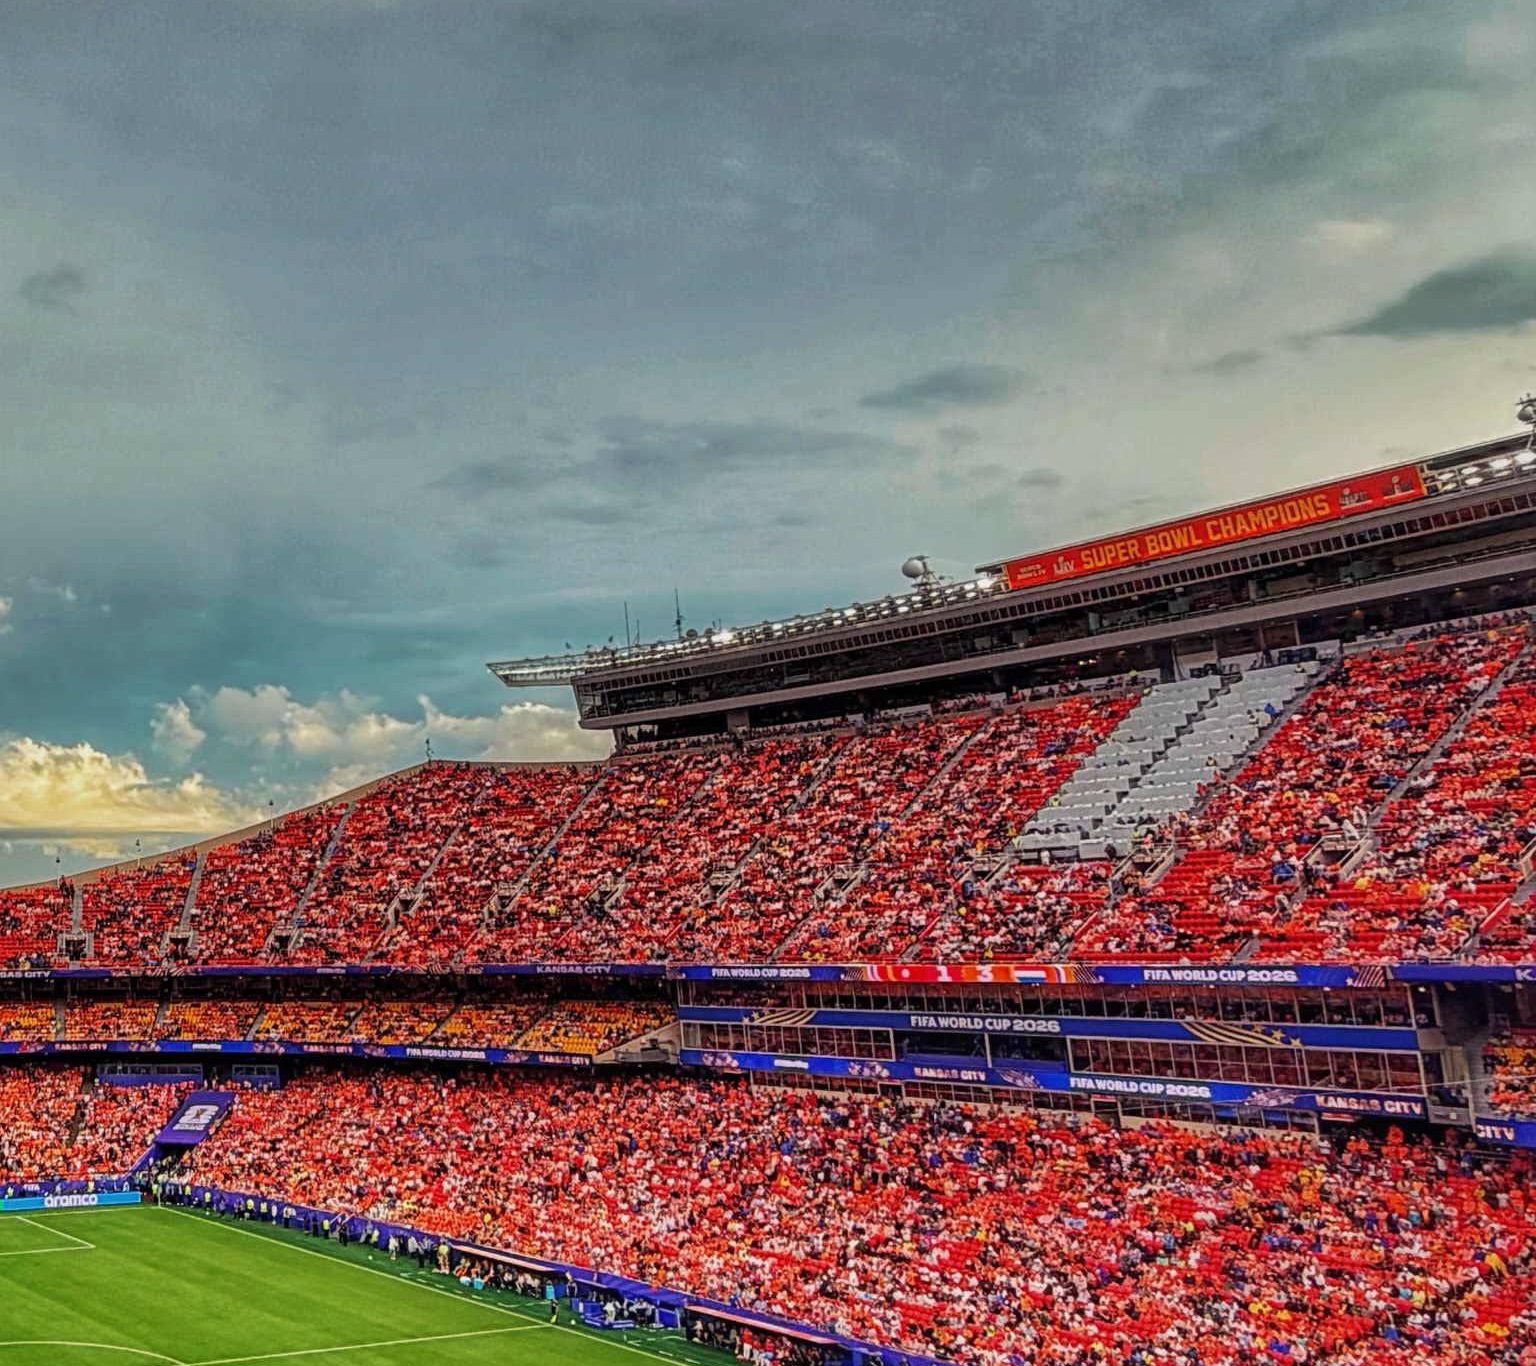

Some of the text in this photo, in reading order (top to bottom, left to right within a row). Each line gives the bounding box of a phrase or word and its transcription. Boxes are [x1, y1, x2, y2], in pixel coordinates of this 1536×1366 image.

[1080, 494, 1330, 570] SUPER BOWL CHAMPIONS
[536, 965, 611, 974] KANSAS CITY
[712, 968, 810, 977] FIFA WORLD CUP 2026
[936, 965, 994, 982] 1 3
[1143, 969, 1299, 982] FIFA WORLD CUP 2026
[910, 1015, 1061, 1033] FIFA WORLD CUP 2026
[914, 1066, 986, 1082] KANSAS CITY
[1070, 1077, 1211, 1098] FIFA WORLD CUP 2026
[1315, 1094, 1422, 1115] KANSAS CITY
[1476, 1124, 1515, 1141] CITY
[44, 1193, 98, 1208] aramco
